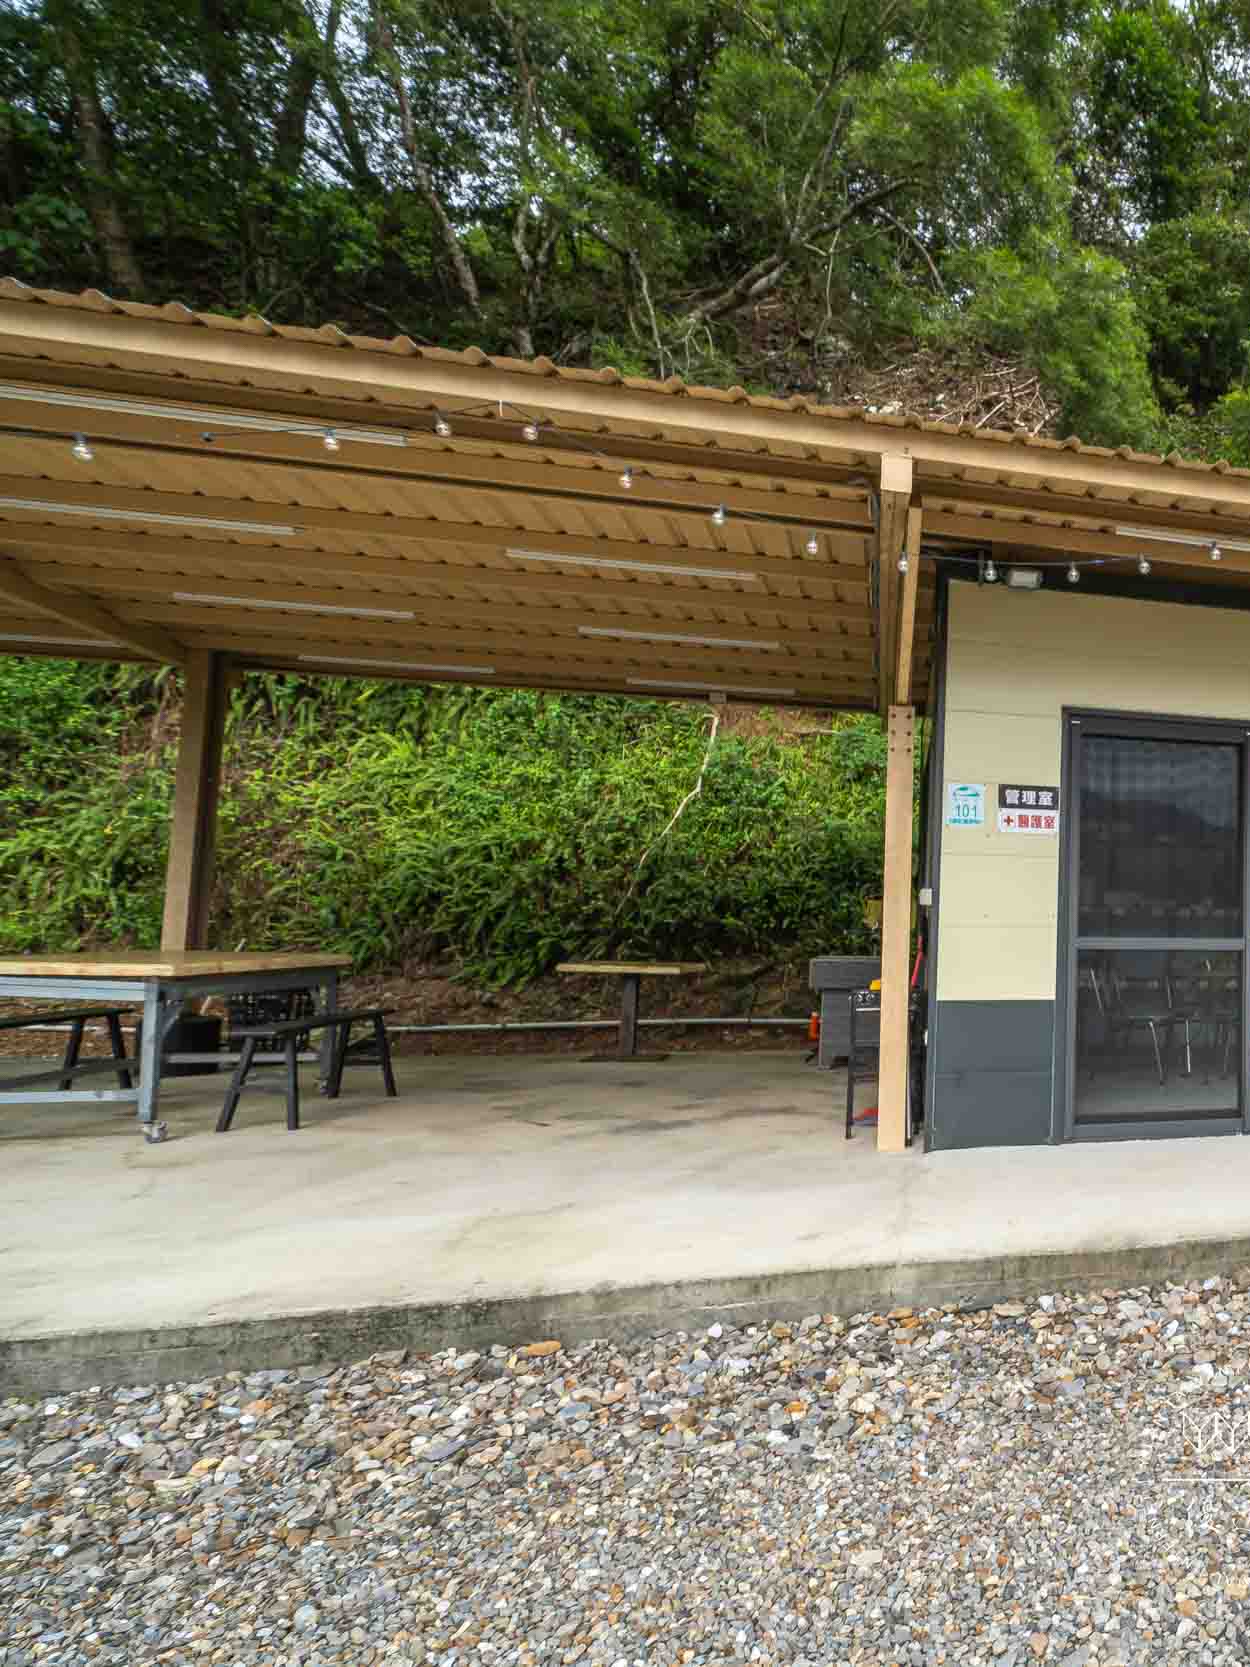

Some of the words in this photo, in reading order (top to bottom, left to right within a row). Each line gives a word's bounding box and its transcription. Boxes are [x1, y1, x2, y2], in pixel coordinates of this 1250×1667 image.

[1005, 789, 1053, 806] 管理室
[956, 803, 977, 817] 101
